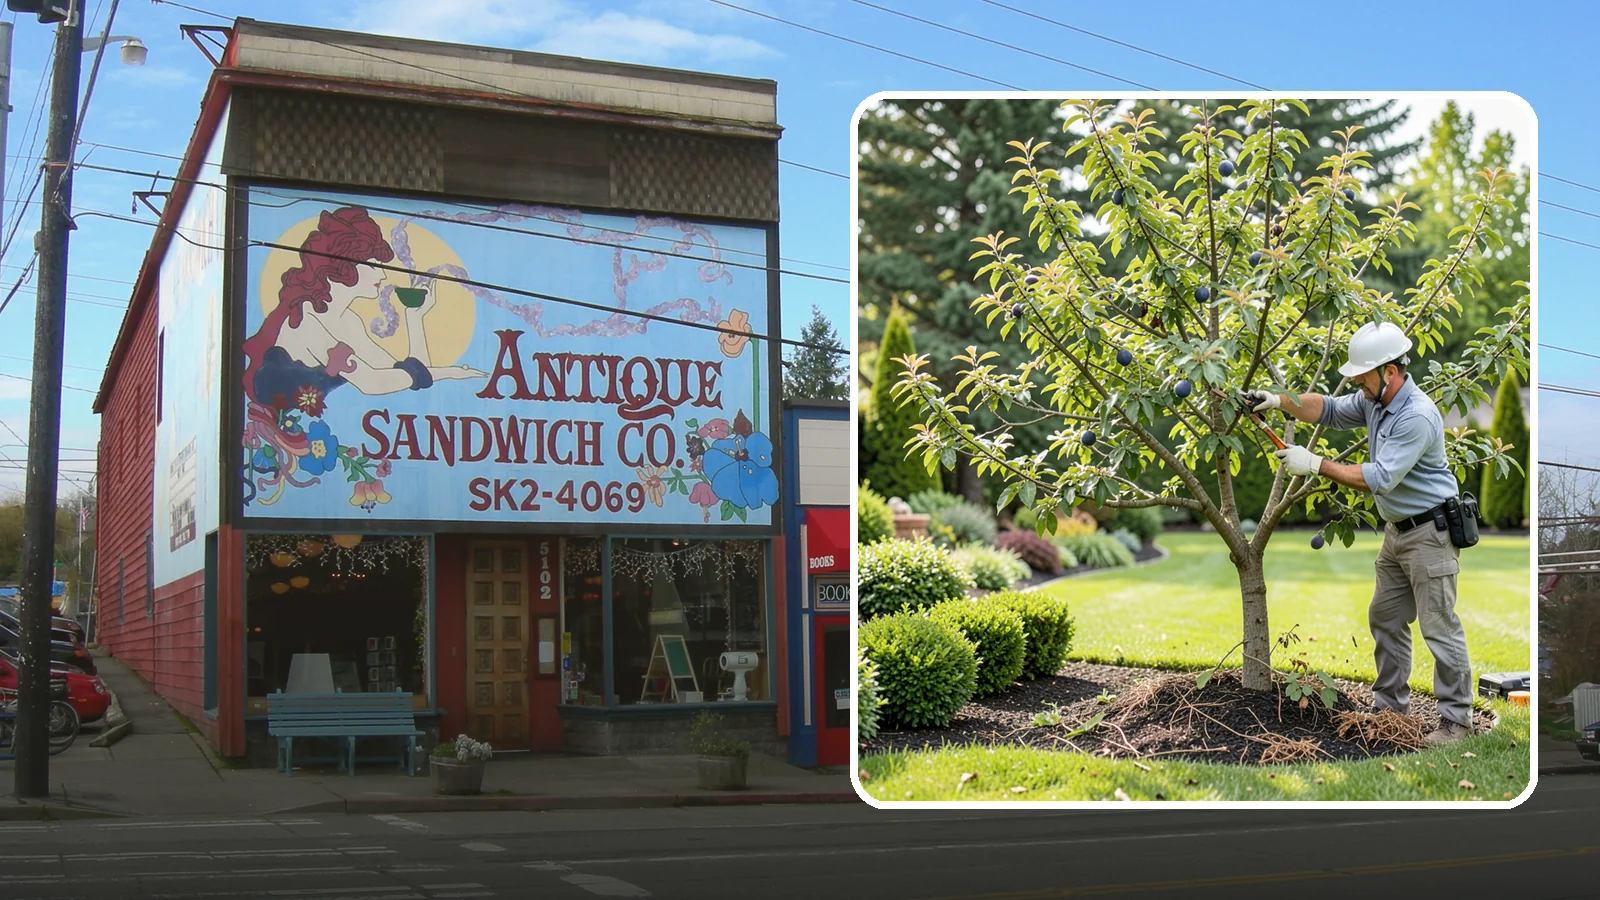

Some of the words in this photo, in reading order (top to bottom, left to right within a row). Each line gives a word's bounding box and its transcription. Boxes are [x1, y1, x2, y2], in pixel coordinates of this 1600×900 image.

[475, 328, 724, 421] ANTIQUE
[361, 408, 605, 467] SANDWICH
[617, 421, 685, 469] CO.
[468, 477, 646, 513] SK2-4069
[539, 541, 552, 600] 5102
[809, 555, 835, 569] BOOKS
